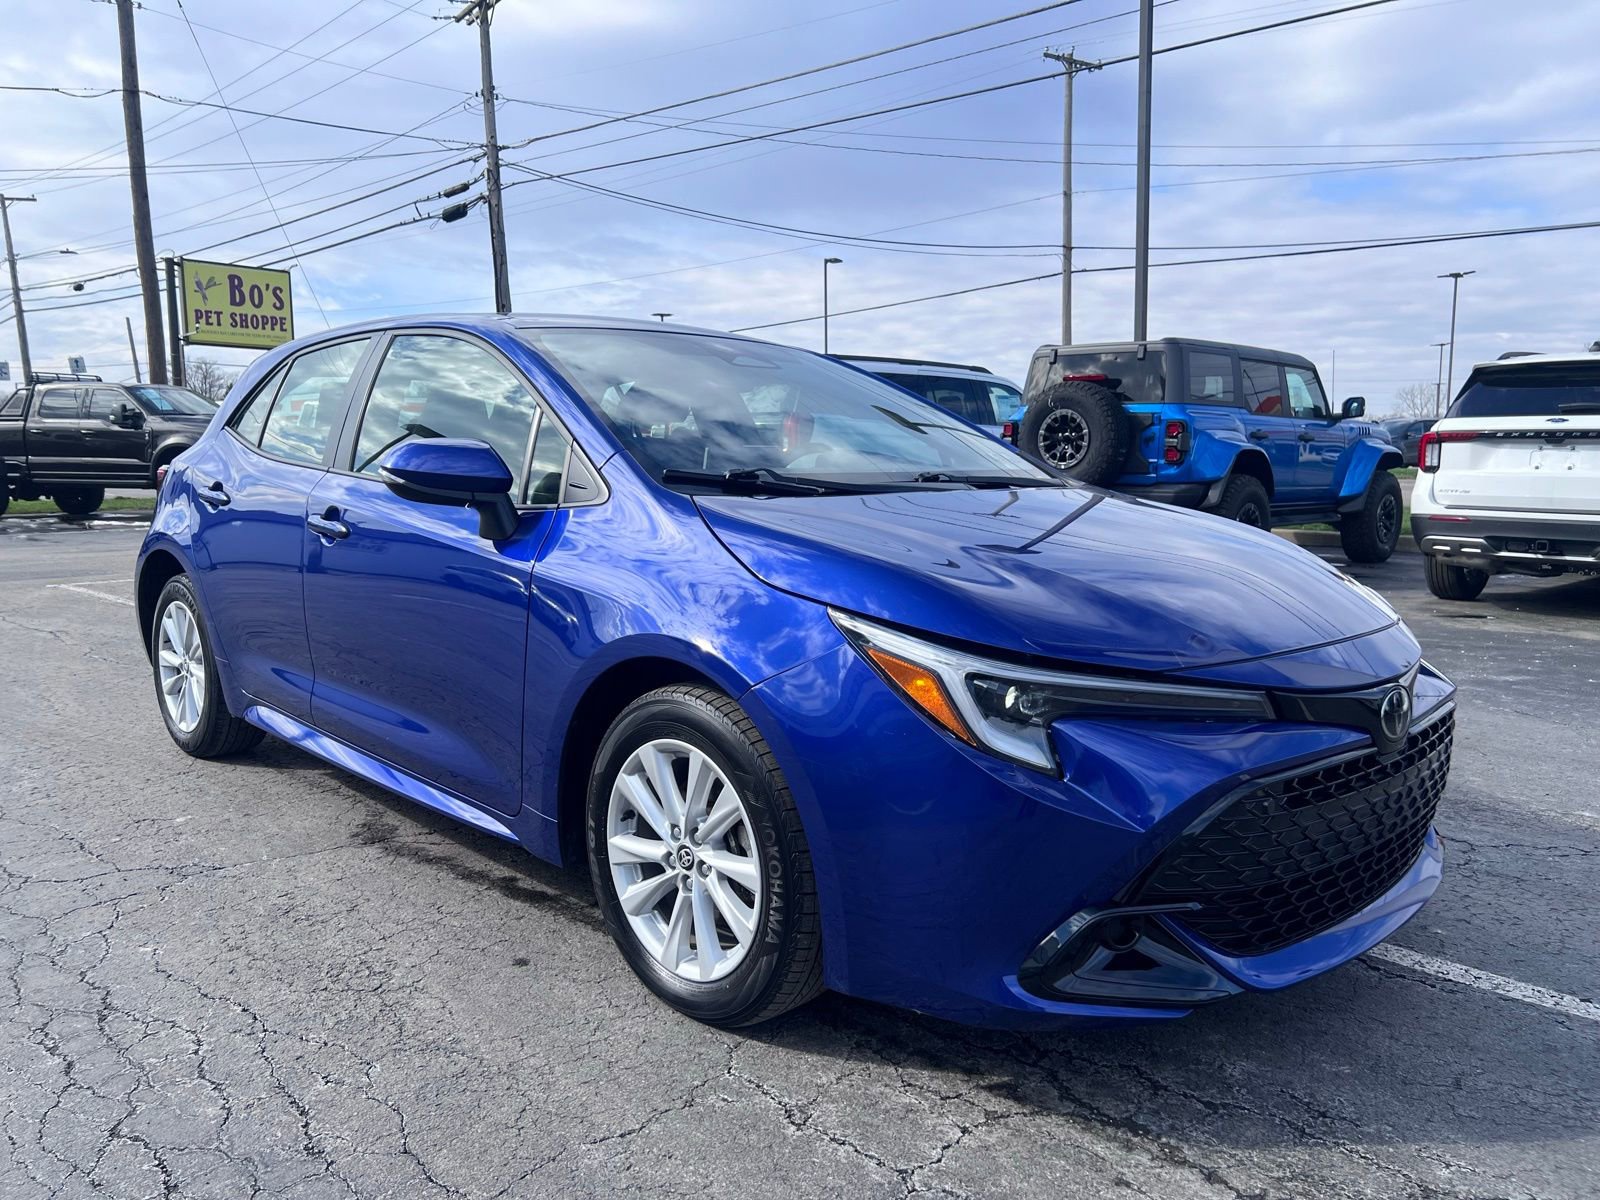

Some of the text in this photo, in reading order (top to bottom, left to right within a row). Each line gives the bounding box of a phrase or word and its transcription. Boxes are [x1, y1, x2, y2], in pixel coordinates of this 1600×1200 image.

[194, 308, 288, 332] PET SHOPPE
[759, 813, 784, 944] YOKOHAMA
